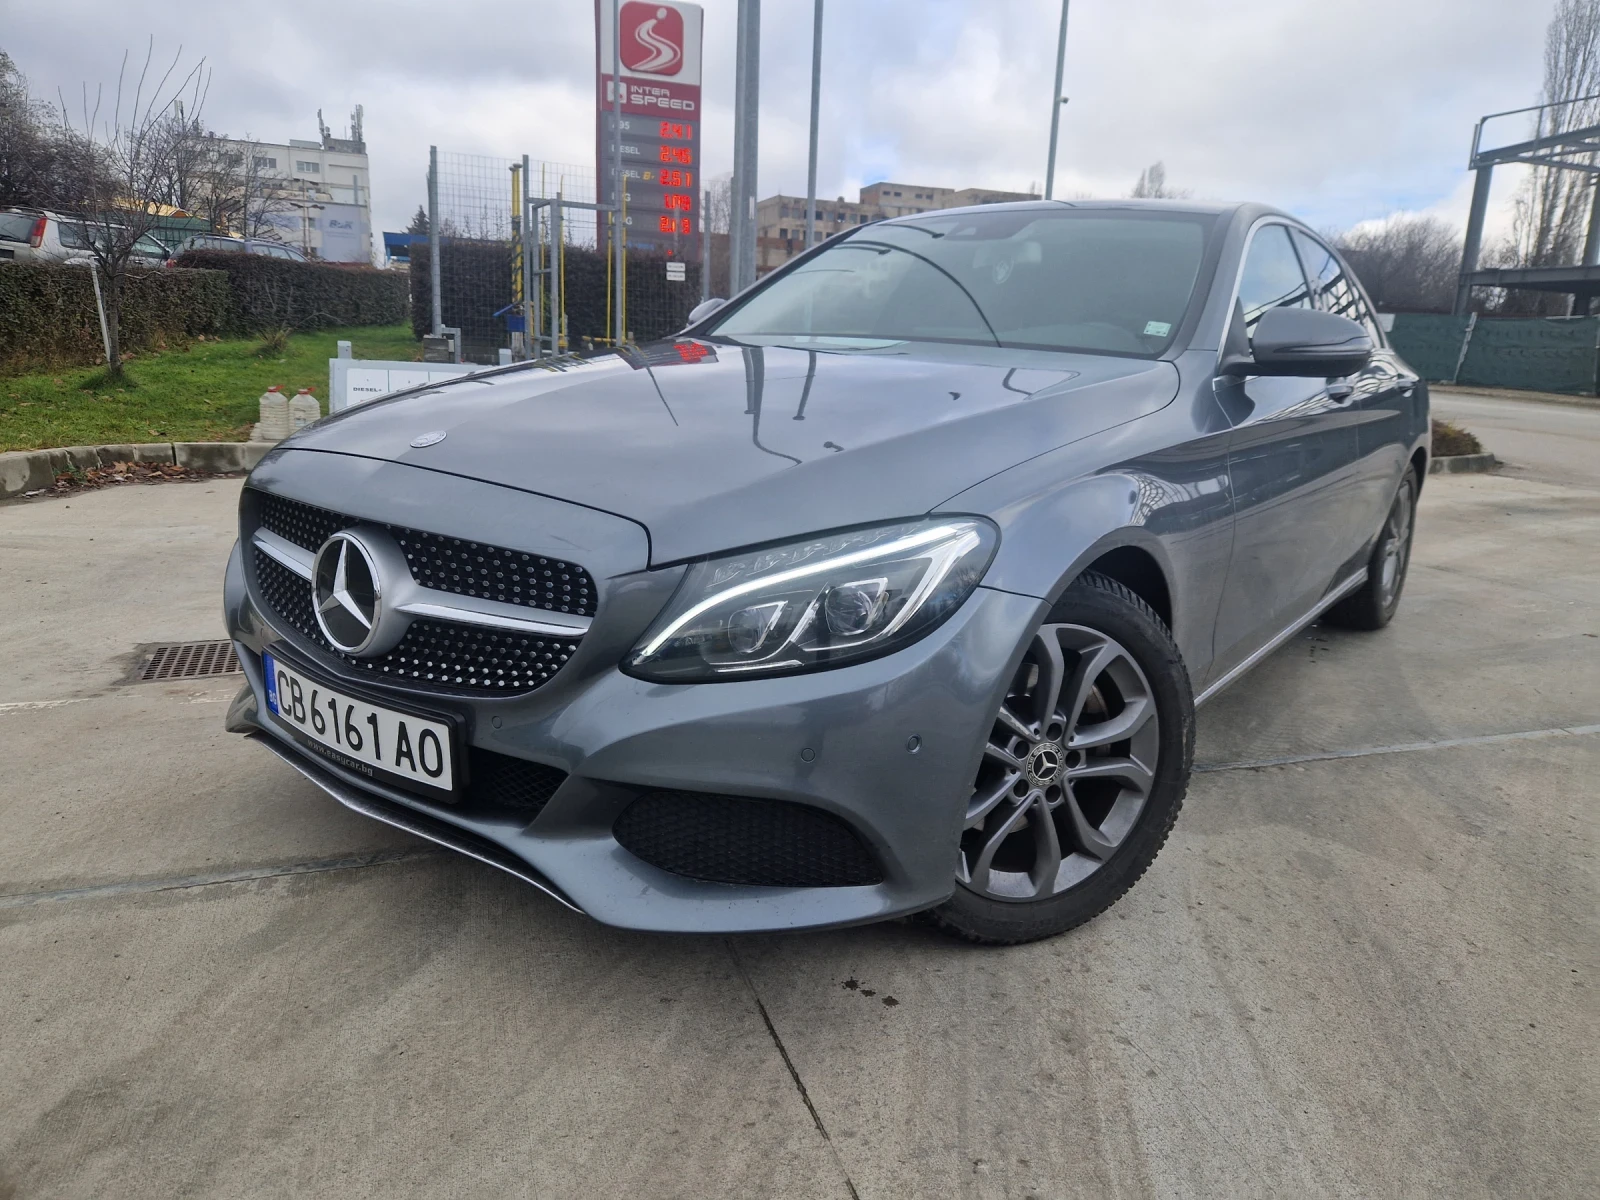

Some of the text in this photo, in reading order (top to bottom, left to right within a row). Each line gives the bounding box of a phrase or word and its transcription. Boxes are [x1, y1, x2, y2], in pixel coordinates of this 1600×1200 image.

[631, 85, 670, 97] INTER
[630, 94, 695, 111] SPEED
[307, 739, 374, 777] www.easycar.bg
